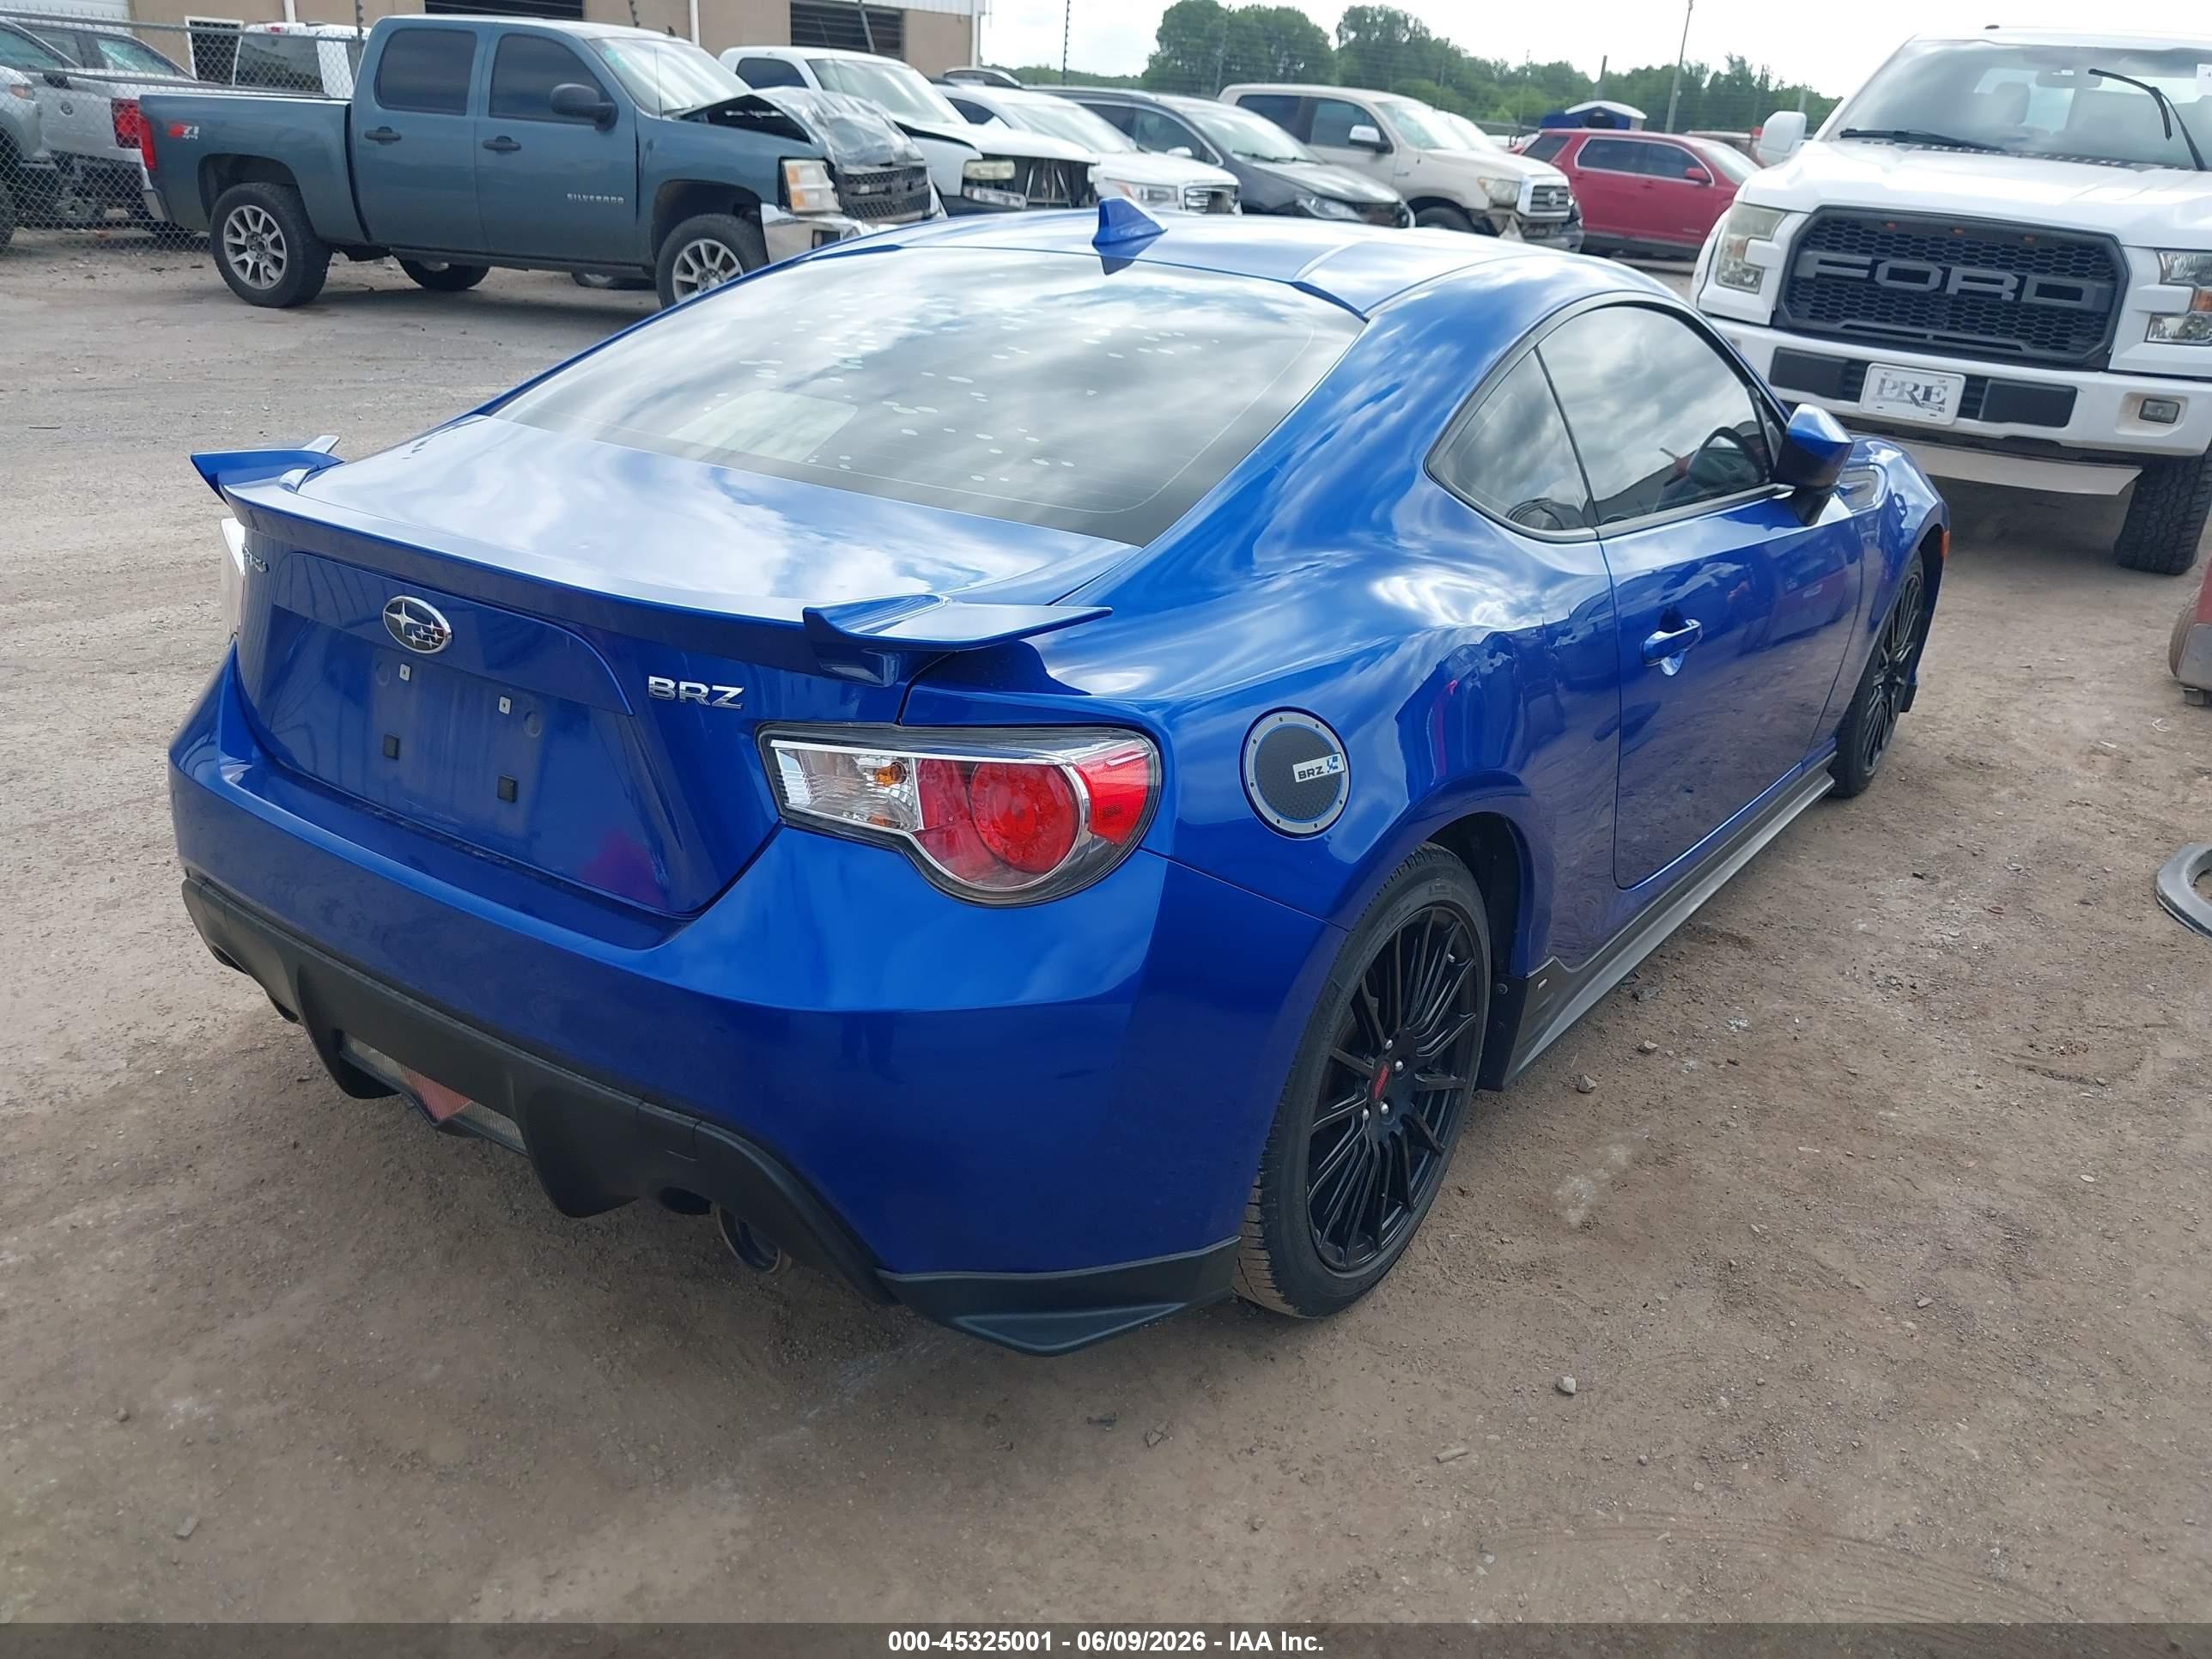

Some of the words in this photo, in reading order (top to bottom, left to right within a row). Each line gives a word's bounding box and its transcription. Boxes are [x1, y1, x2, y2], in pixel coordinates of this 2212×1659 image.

[567, 193, 624, 204] SILVERADO
[1794, 250, 2097, 310] FORD
[648, 676, 744, 709] BRZ
[1297, 765, 1324, 780] BRZ
